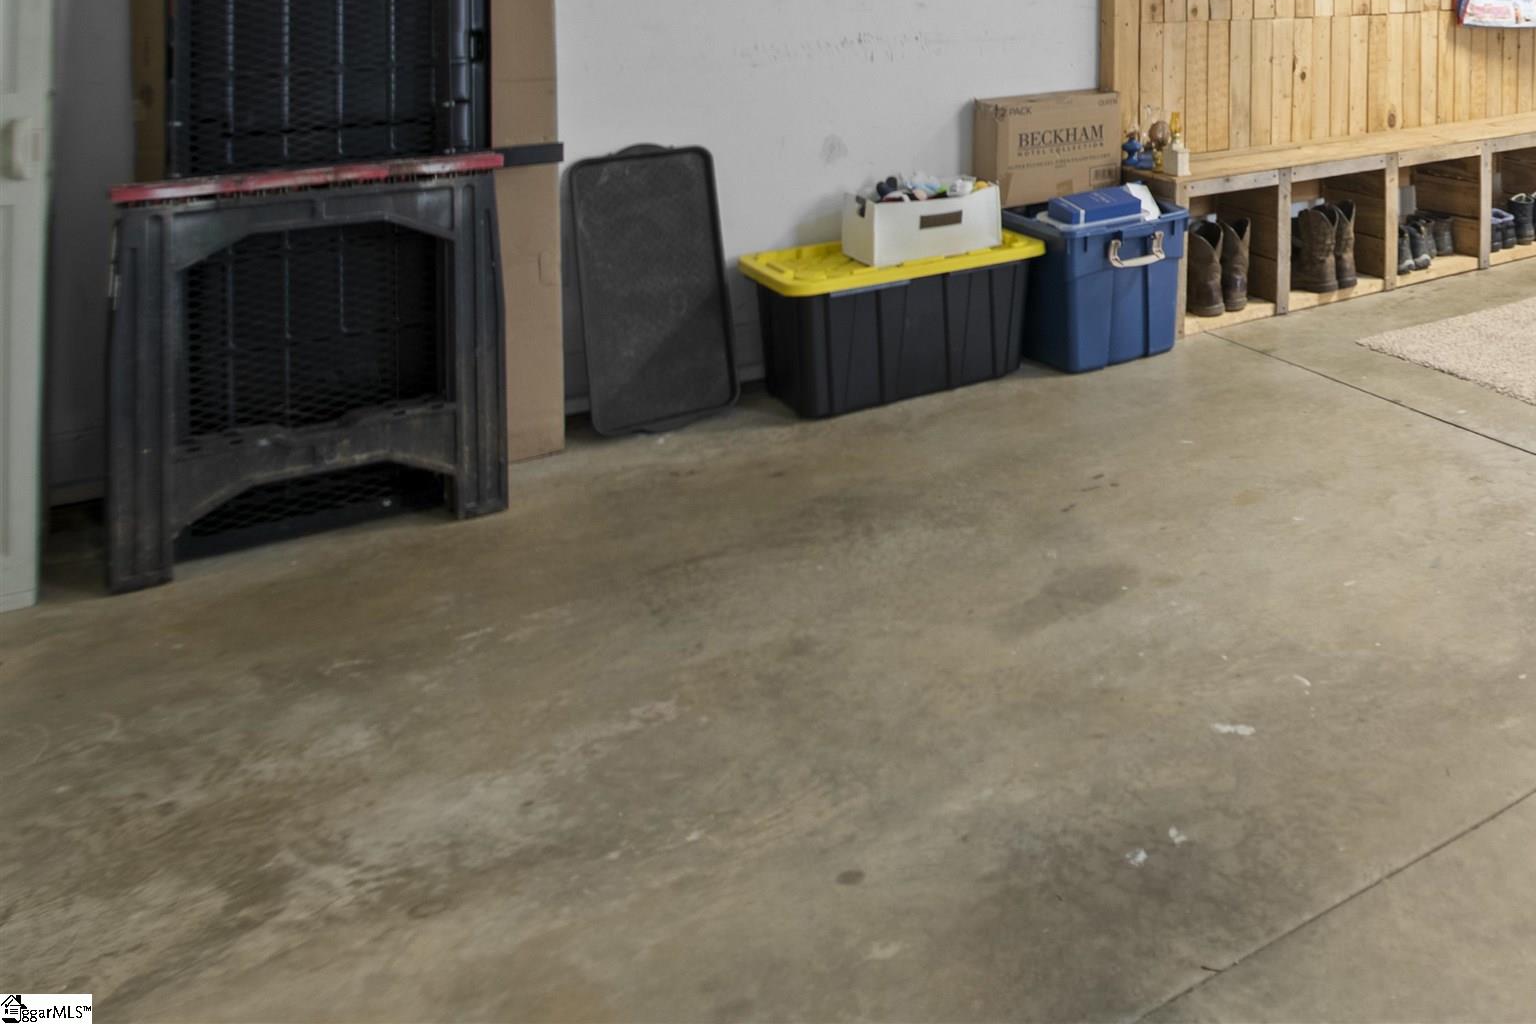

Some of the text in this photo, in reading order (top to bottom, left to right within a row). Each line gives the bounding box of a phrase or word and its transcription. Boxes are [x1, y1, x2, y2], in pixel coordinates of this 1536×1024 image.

[1008, 106, 1032, 116] PACK
[1018, 123, 1104, 147] BECKHAM
[1017, 141, 1104, 157] HOTEL COLLECTION
